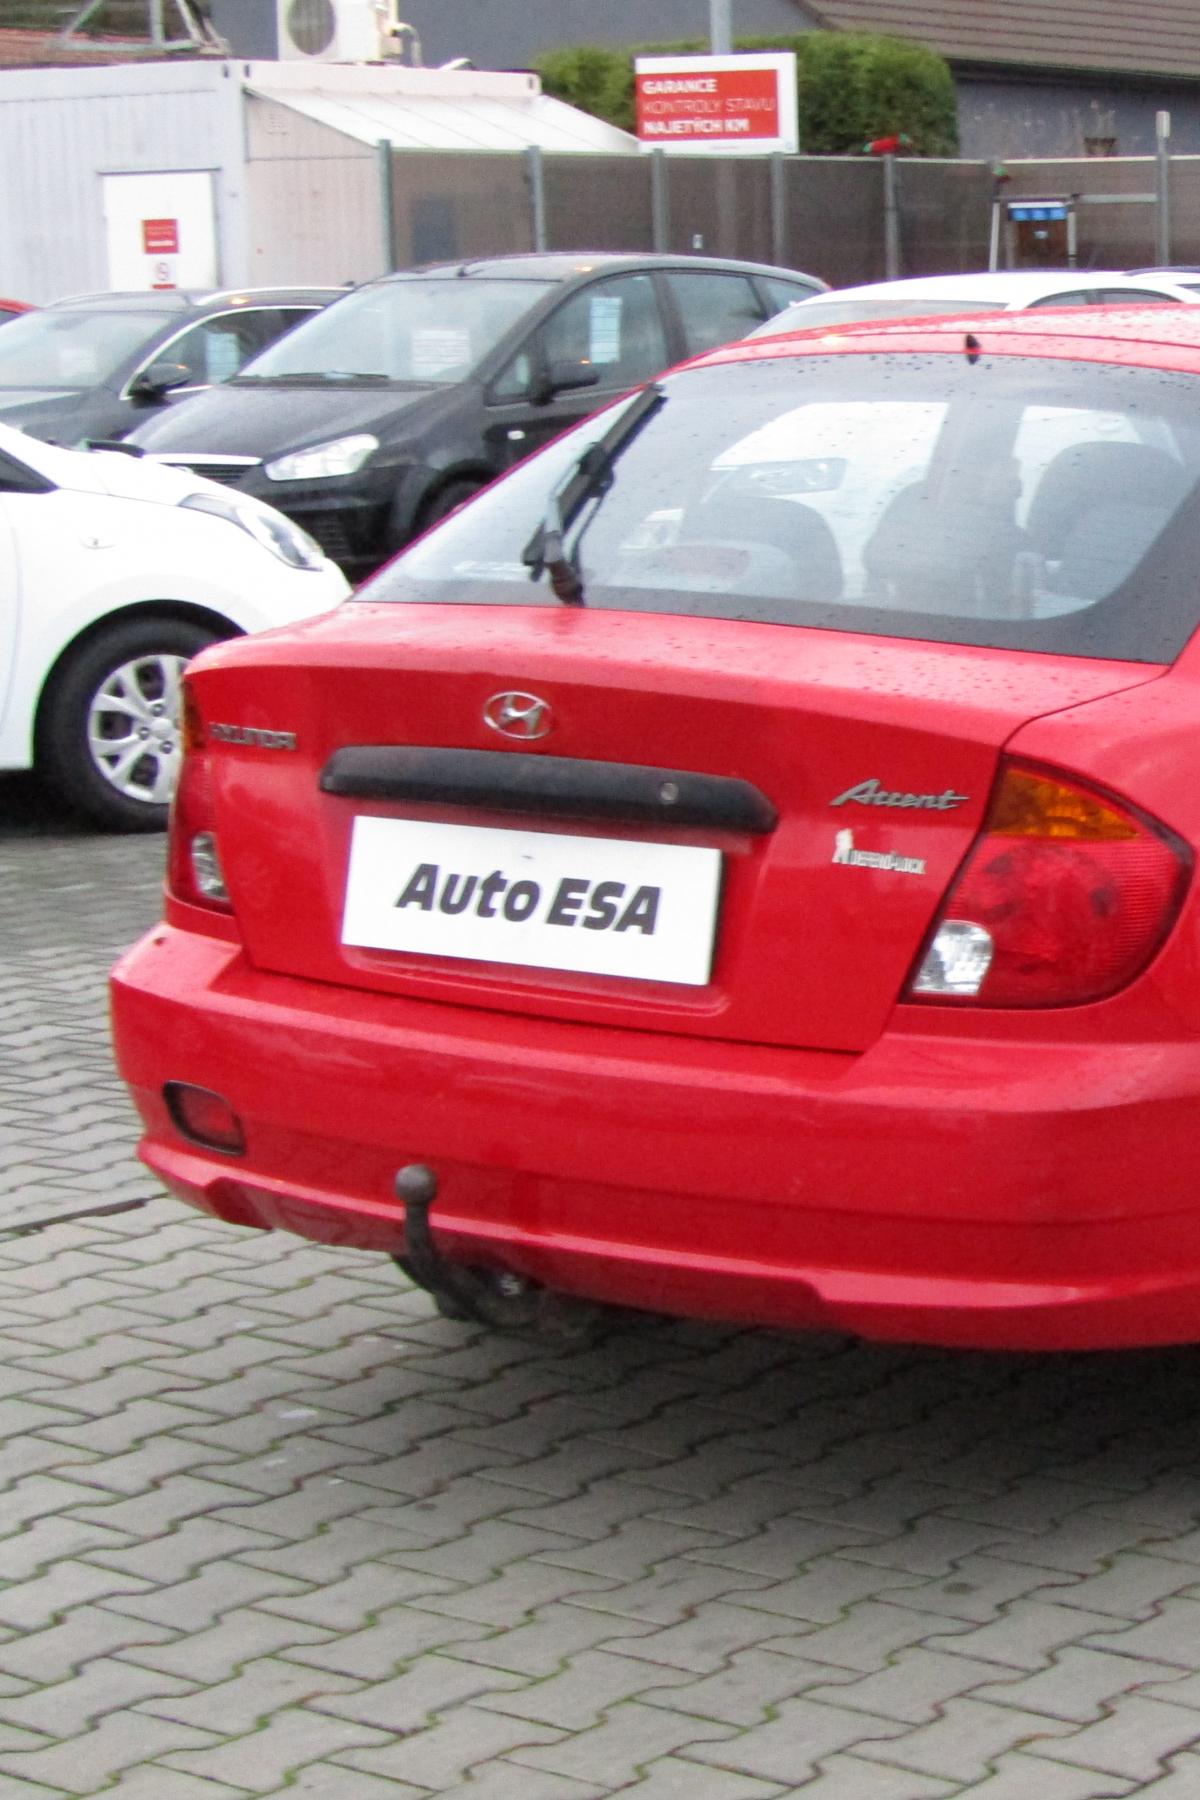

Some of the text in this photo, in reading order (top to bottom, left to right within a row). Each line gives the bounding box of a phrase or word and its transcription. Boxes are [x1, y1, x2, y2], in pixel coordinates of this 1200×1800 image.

[643, 79, 717, 94] GARANCE
[829, 778, 970, 810] Accent
[394, 863, 662, 936] Auto ESA
